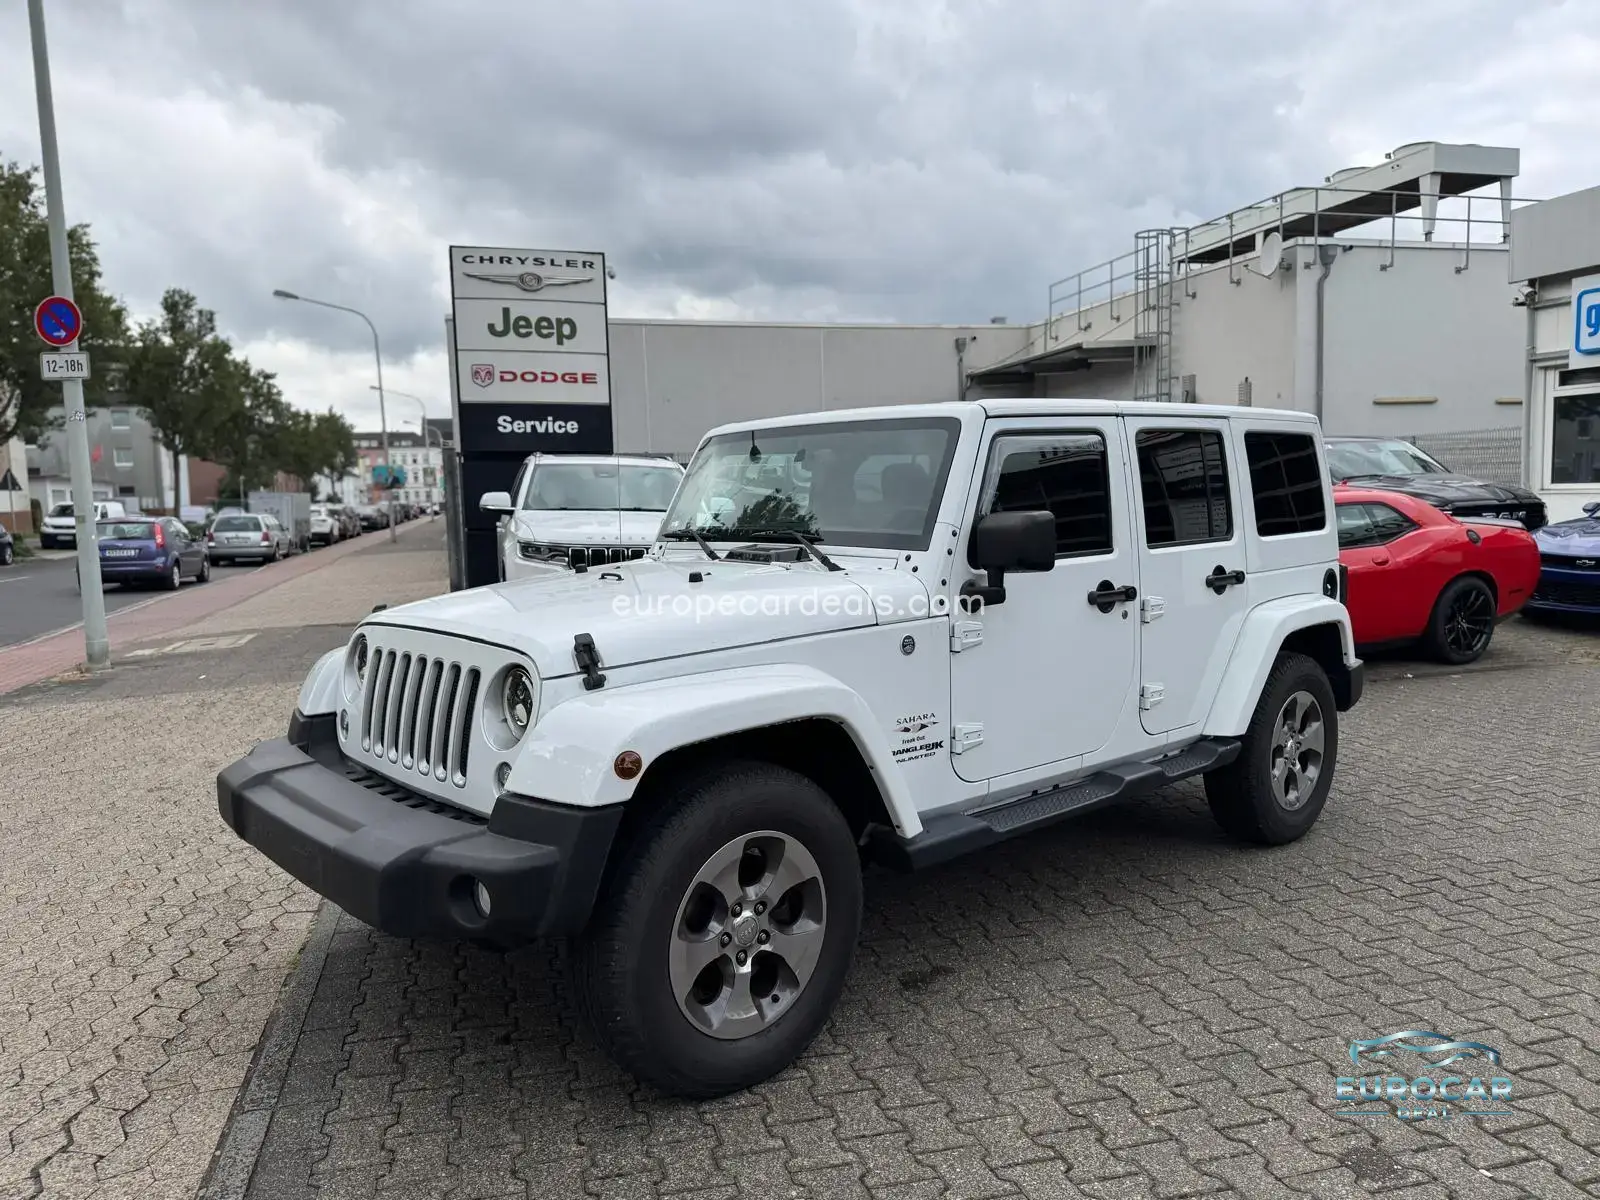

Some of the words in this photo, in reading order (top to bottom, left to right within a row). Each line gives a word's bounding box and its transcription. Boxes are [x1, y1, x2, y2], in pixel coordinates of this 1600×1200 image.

[462, 255, 596, 269] CHRYSLER
[487, 307, 577, 346] Jeep
[46, 360, 83, 372] 12-18h
[499, 371, 598, 384] DODGE
[497, 415, 579, 434] Service
[896, 713, 936, 725] SAHARA
